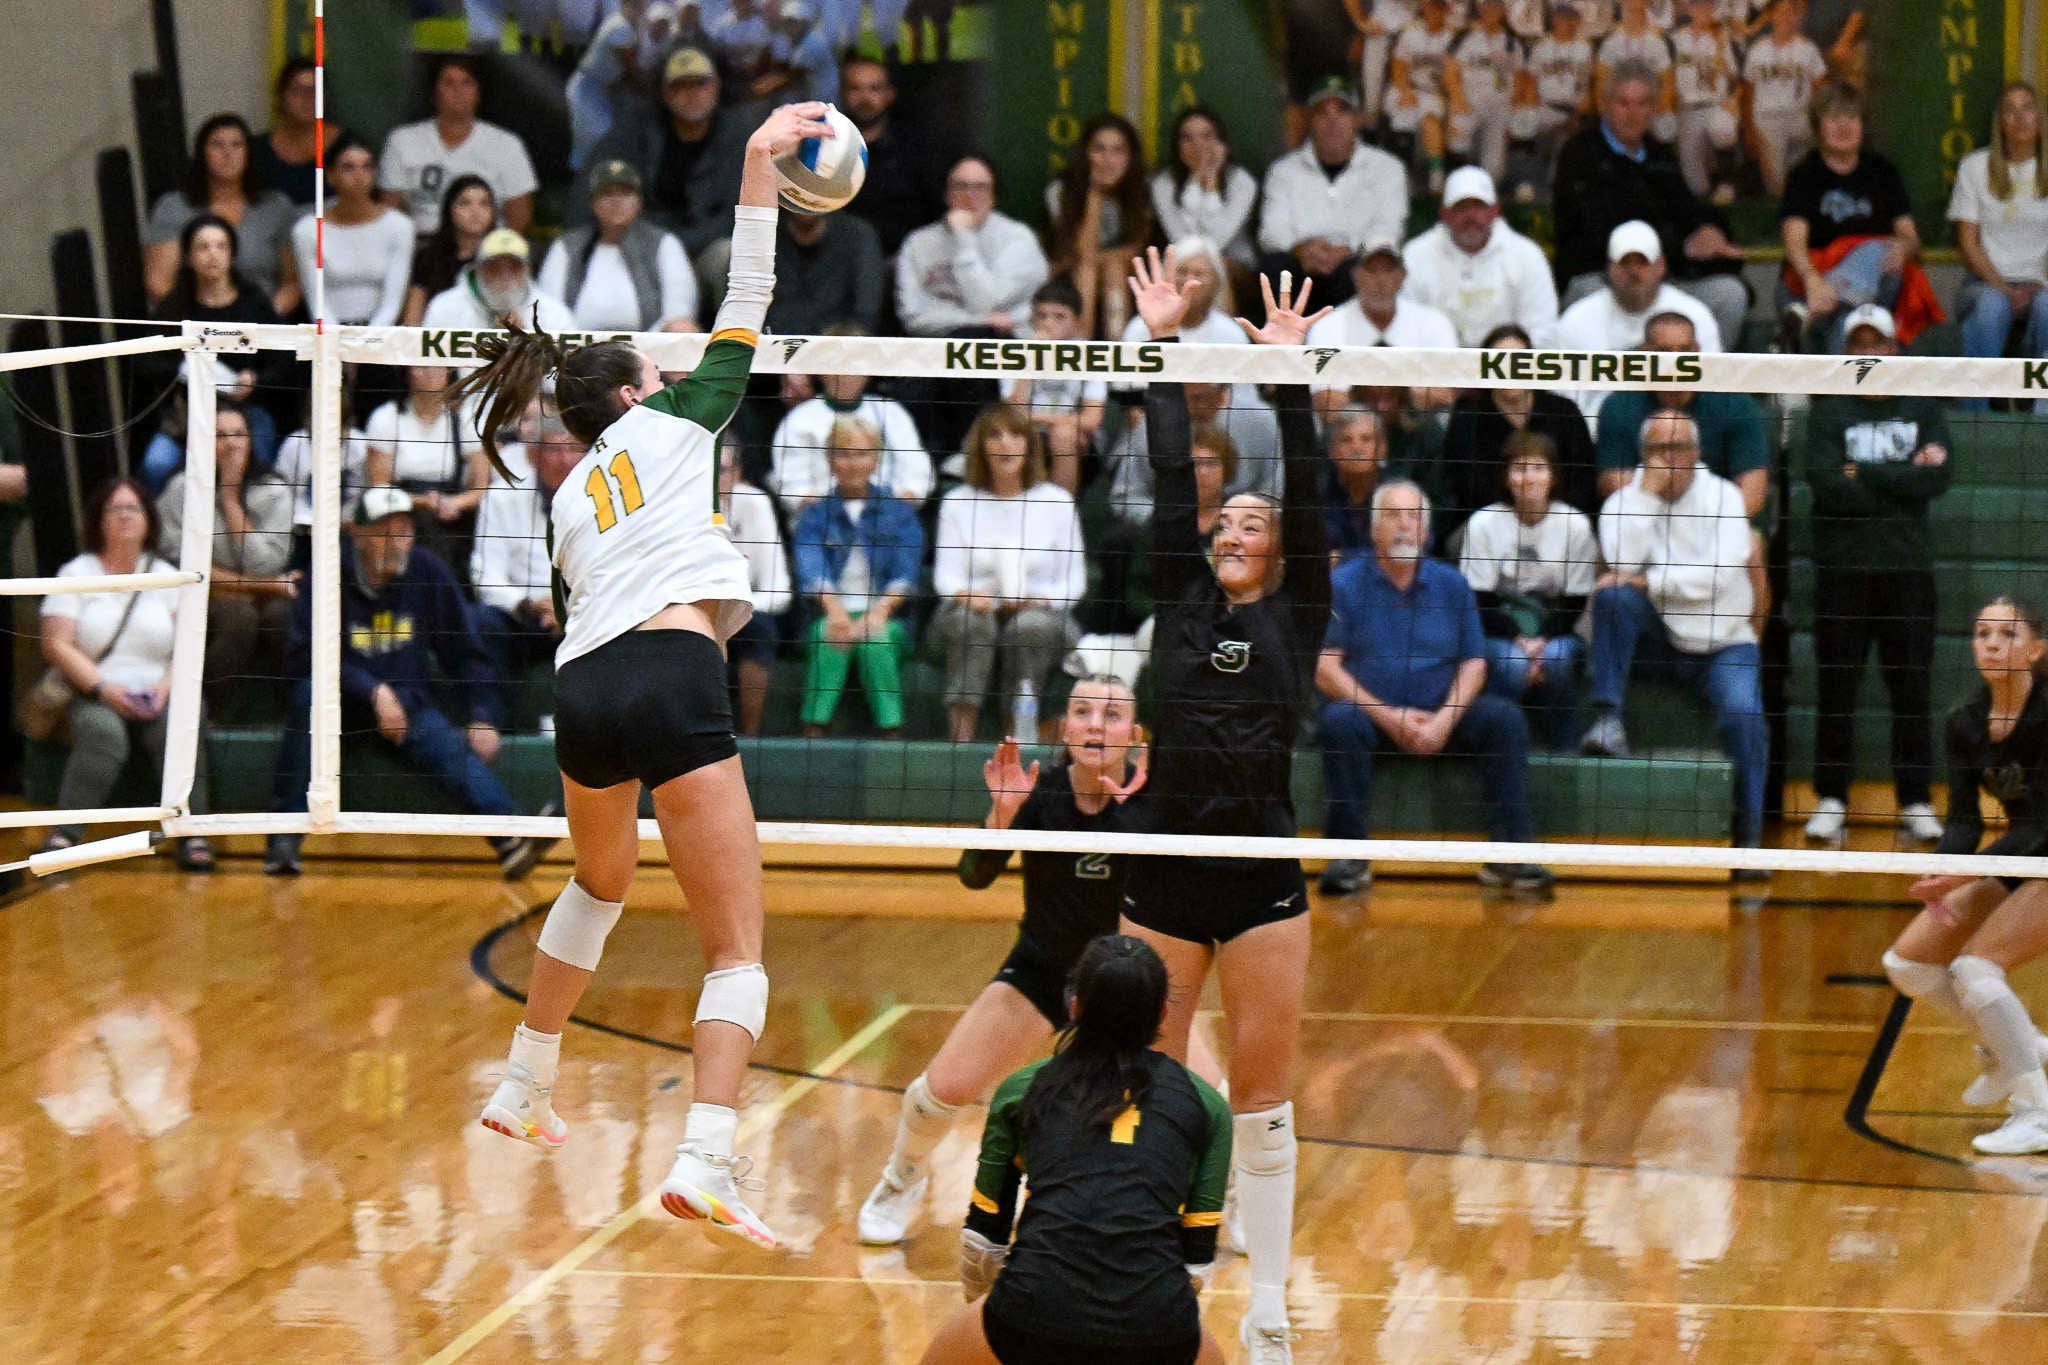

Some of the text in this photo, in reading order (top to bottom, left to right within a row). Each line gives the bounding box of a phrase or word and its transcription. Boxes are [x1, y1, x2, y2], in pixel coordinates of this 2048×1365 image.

[1048, 2, 1081, 169] MPIO
[1940, 0, 1977, 190] MPIO
[946, 342, 1164, 372] KESTRELS
[1480, 351, 1703, 382] KESTRELS
[2023, 361, 2048, 389] K
[584, 449, 645, 534] 11
[1075, 853, 1111, 880] 2
